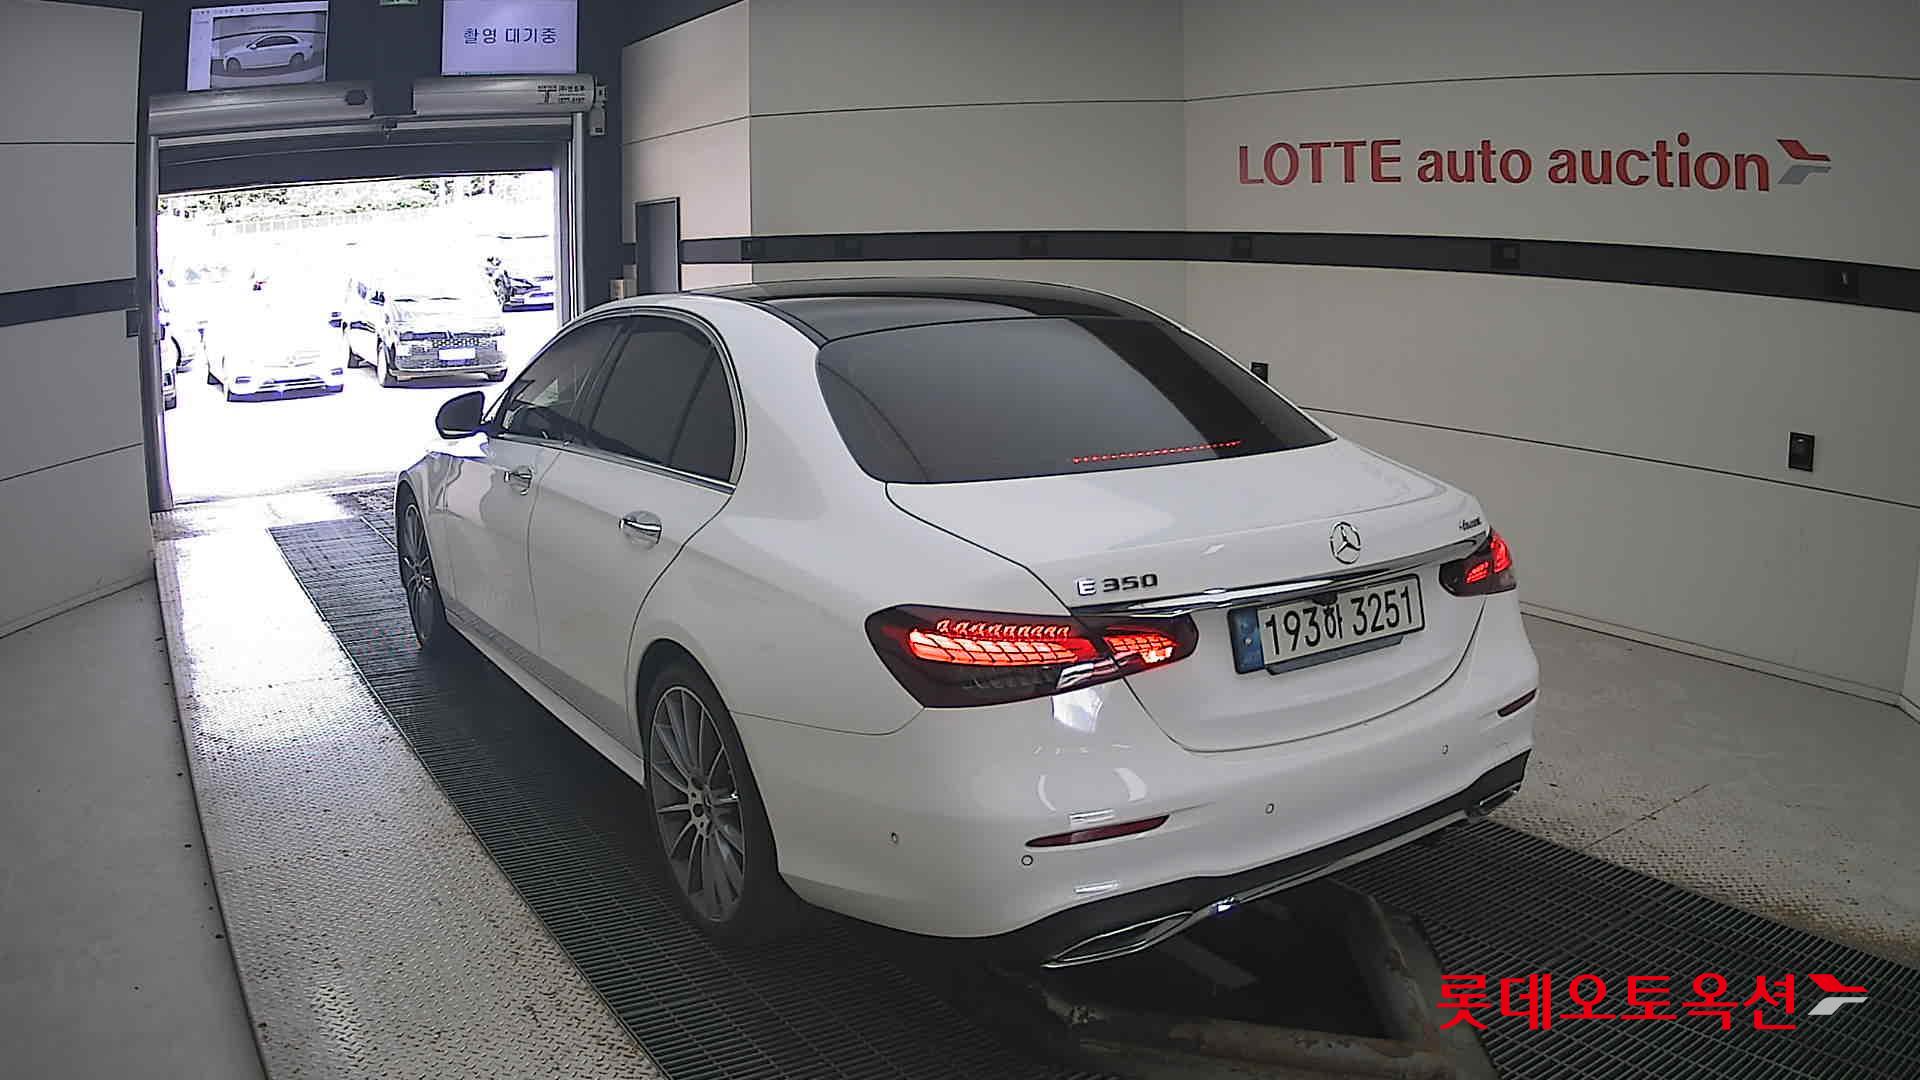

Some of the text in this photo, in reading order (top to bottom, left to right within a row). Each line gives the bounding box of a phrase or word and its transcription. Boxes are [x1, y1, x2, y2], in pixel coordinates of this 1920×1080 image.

[464, 27, 557, 44] 촬영 대기중
[1239, 131, 1770, 192] LOTTE auto auction
[1076, 573, 1158, 597] E 350
[1265, 585, 1413, 655] 193하 3251
